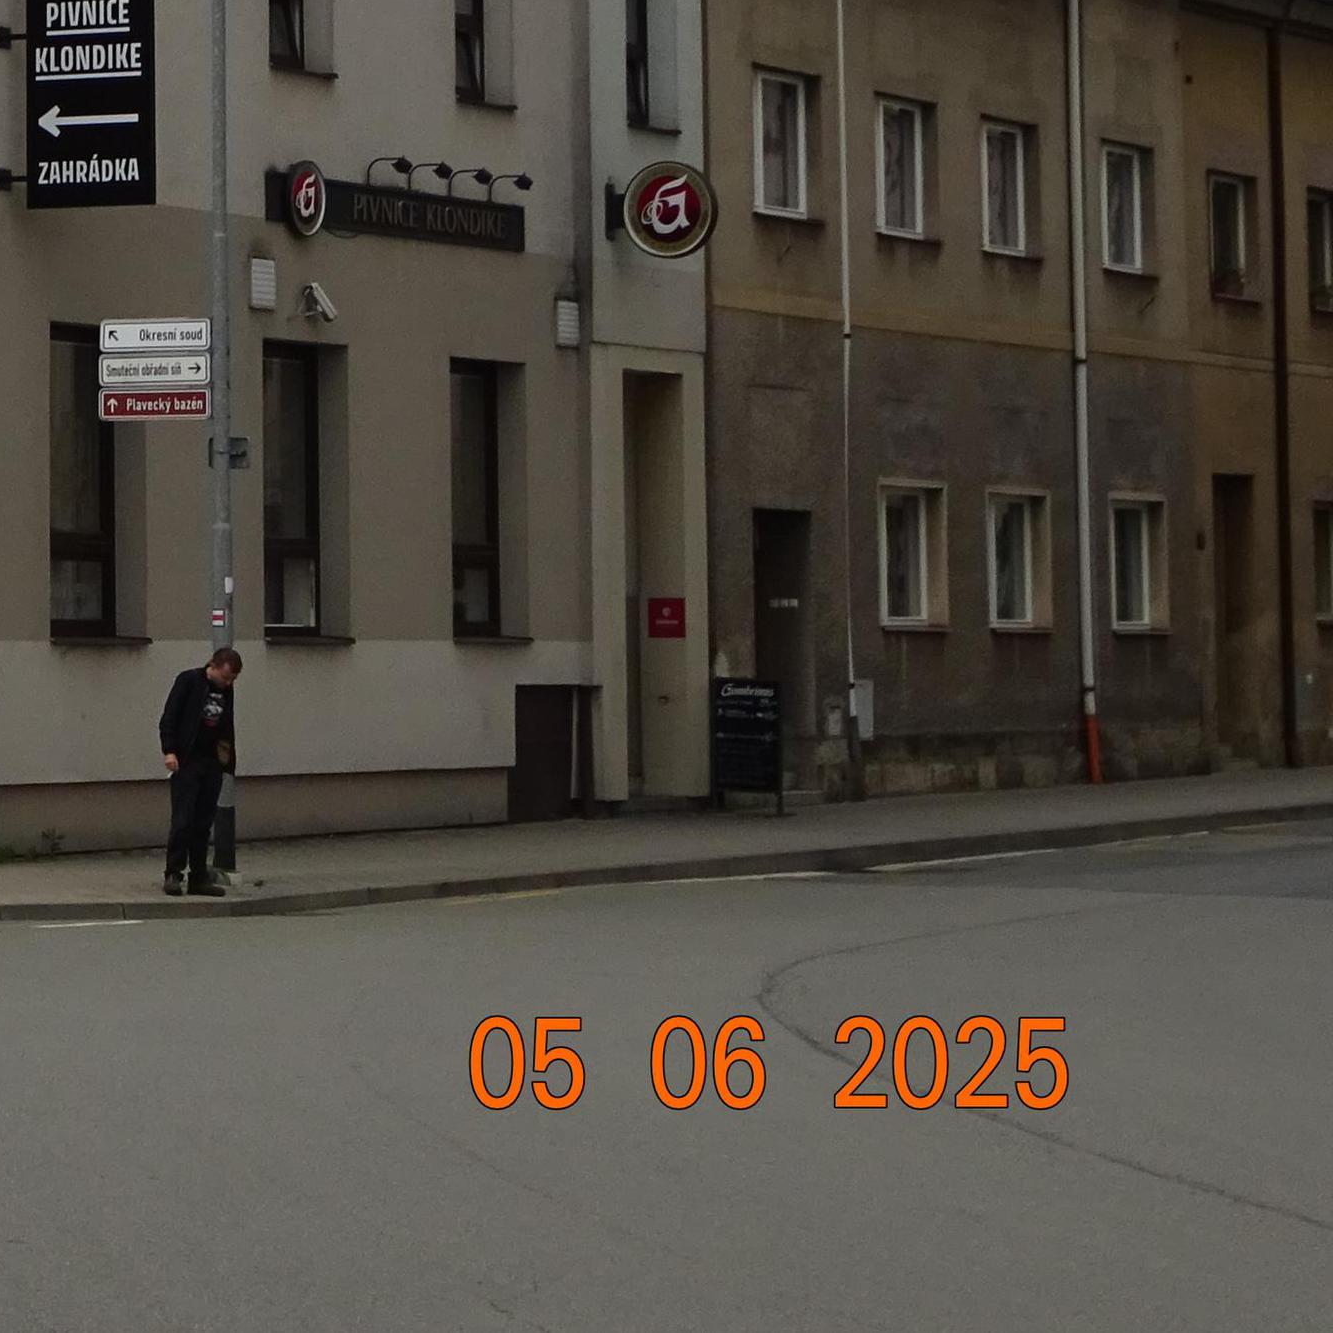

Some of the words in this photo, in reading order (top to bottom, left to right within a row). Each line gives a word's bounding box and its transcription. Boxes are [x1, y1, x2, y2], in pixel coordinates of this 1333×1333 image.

[35, 42, 142, 73] KLONDIKE
[38, 153, 140, 185] ZAHRÁDKA
[353, 194, 419, 228] PIVNICE
[427, 202, 505, 238] KLONDIKE
[139, 328, 177, 341] Okresní
[180, 328, 203, 341] soud
[127, 397, 171, 413] Plavecký
[174, 396, 203, 411] bazén
